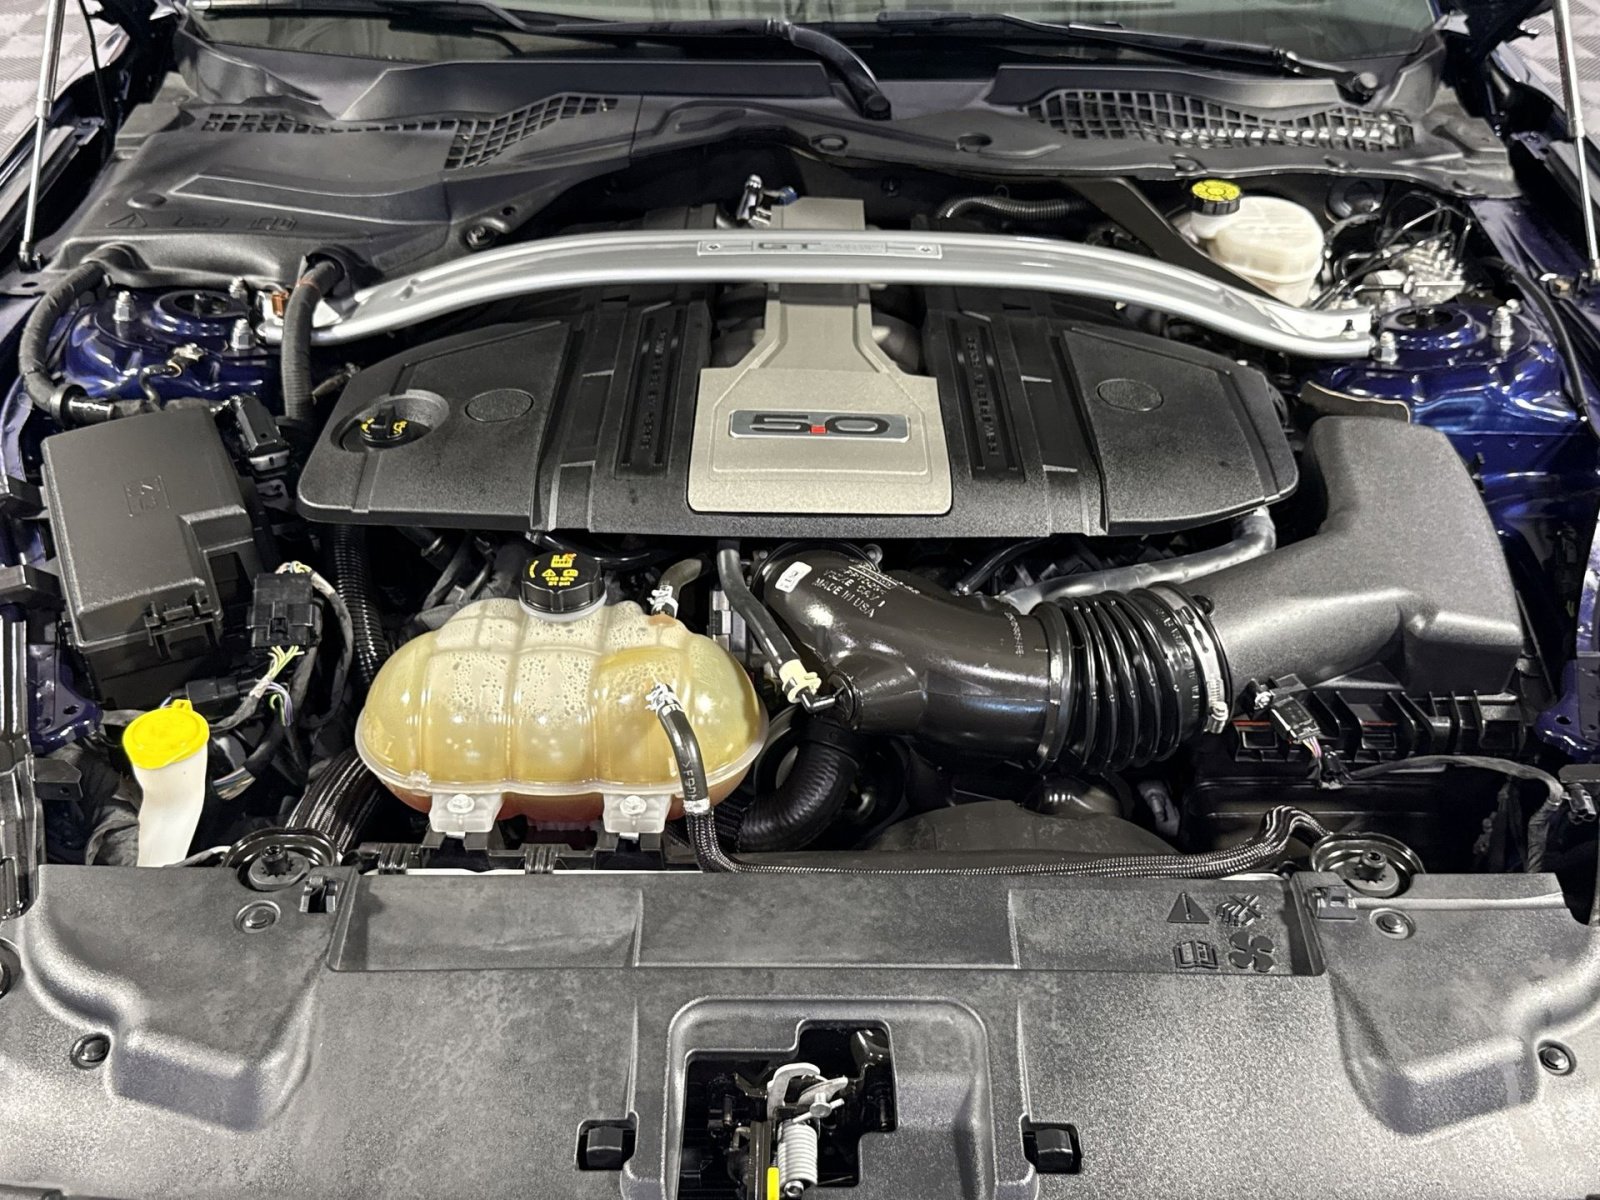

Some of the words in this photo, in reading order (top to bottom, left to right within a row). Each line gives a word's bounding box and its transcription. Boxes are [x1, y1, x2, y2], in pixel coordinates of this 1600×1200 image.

[750, 414, 890, 435] 5.0
[812, 577, 843, 596] MADE
[841, 590, 856, 602] IN
[853, 597, 875, 618] USA
